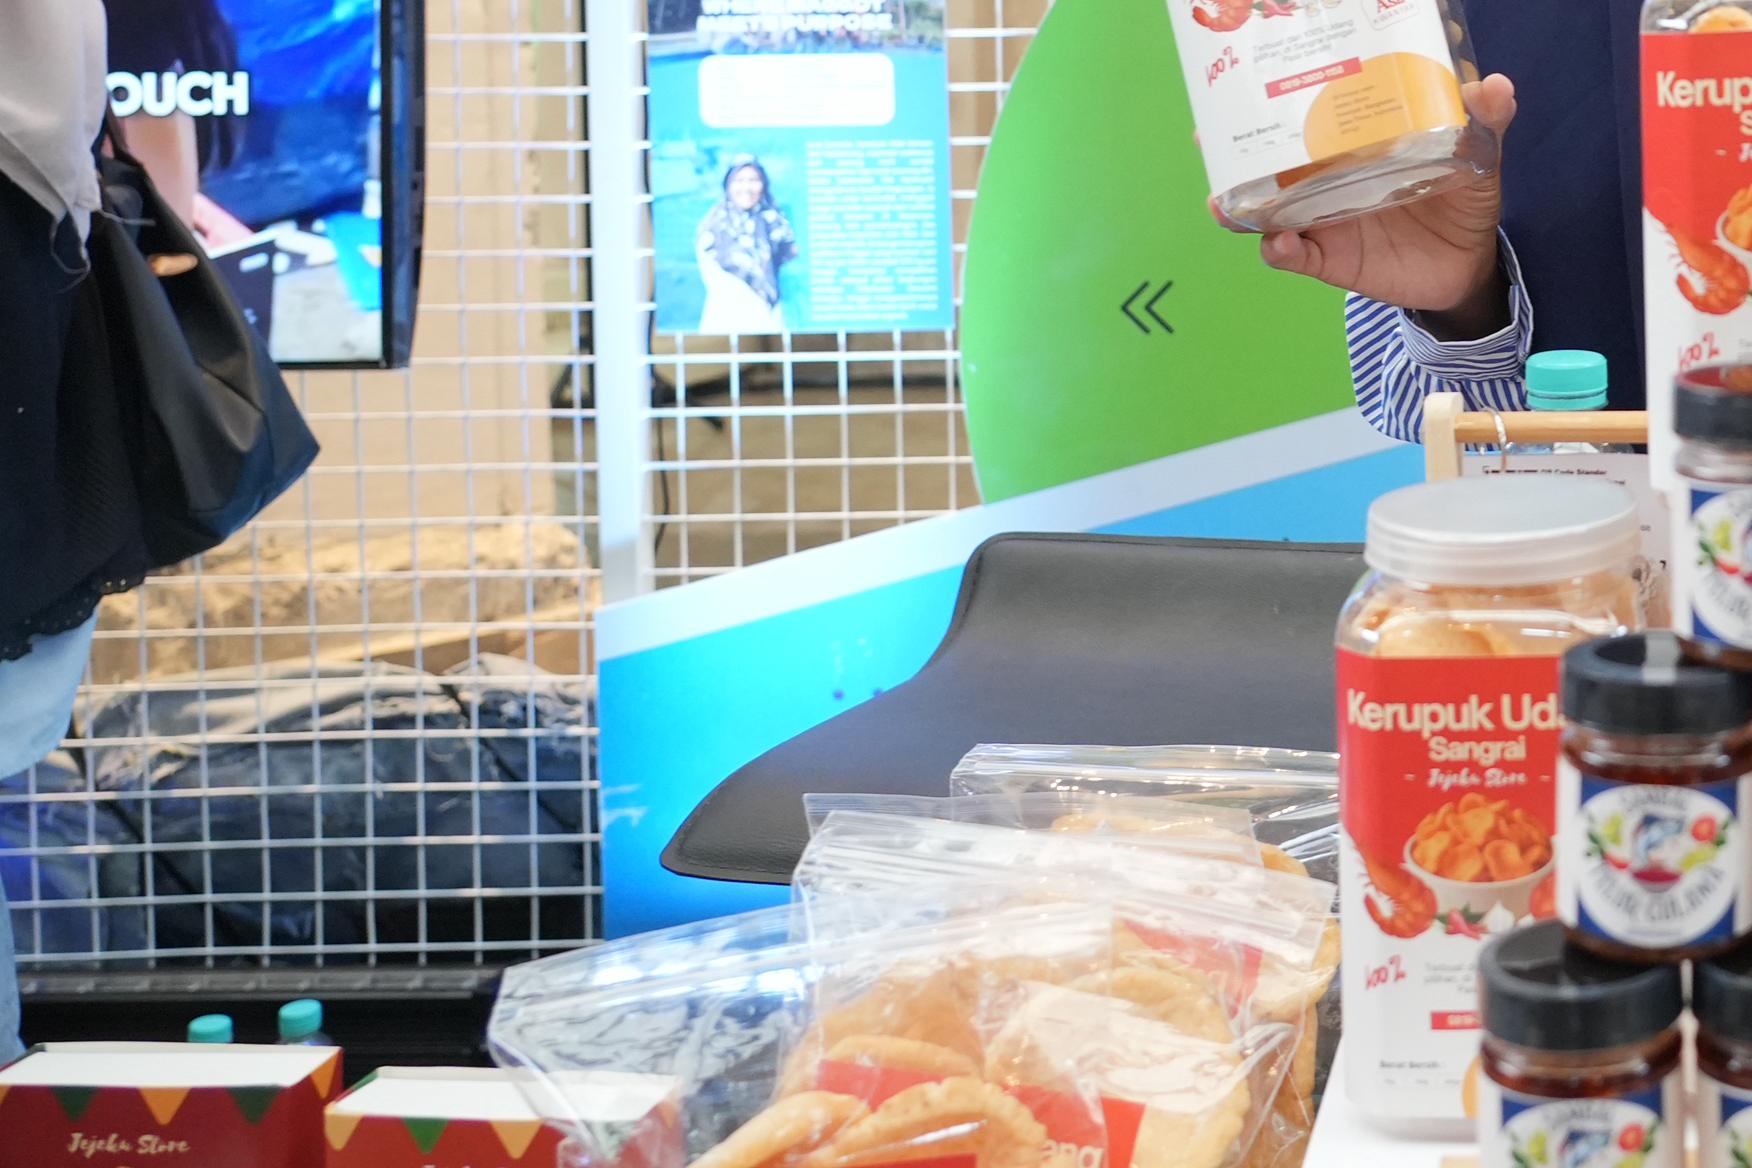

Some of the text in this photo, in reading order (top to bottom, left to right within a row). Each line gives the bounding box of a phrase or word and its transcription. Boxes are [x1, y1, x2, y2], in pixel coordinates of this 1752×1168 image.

[1347, 688, 1495, 740] Kerupuk
[1428, 734, 1527, 767] Sangrai
[136, 1134, 191, 1154] Store
